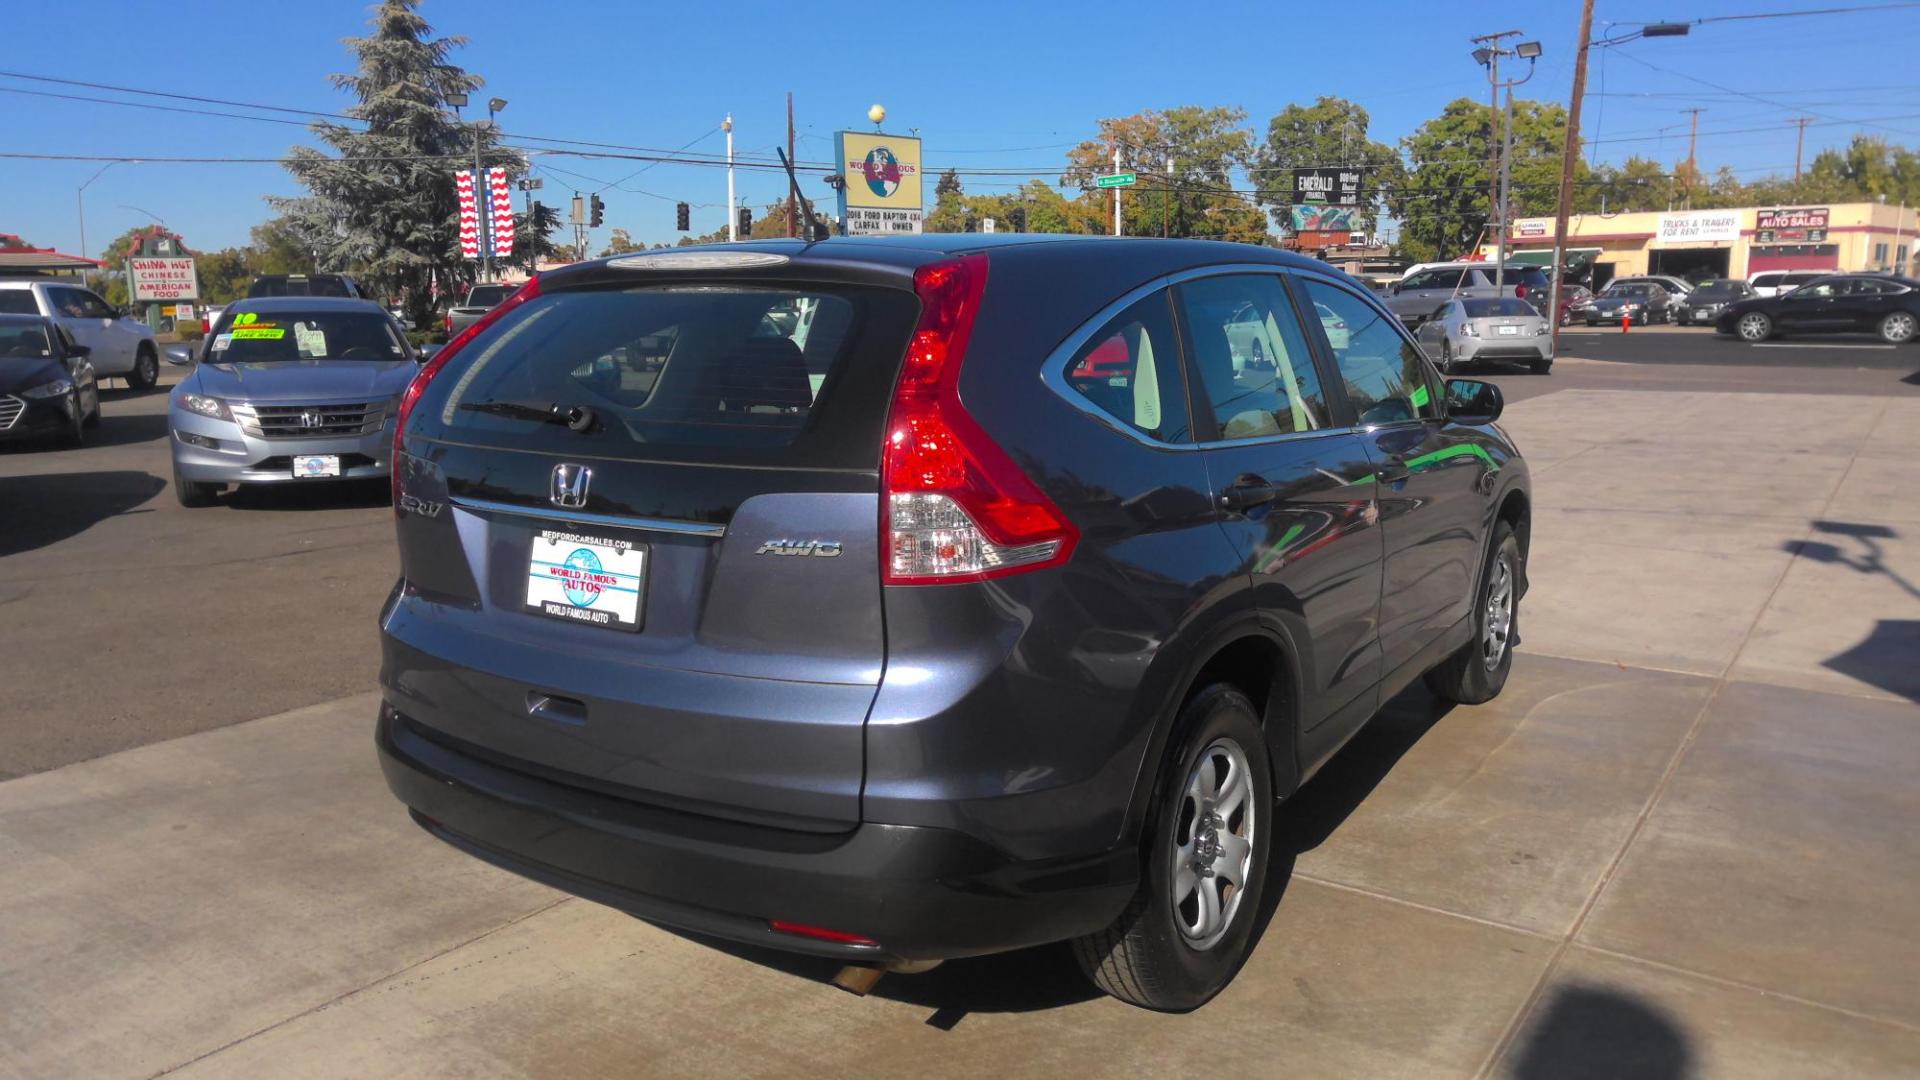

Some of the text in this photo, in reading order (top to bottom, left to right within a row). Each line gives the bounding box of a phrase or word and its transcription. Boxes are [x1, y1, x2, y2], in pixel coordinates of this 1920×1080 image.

[1298, 176, 1333, 191] EMERALD
[864, 211, 880, 219] FORD
[883, 212, 907, 221] RAPTOR
[854, 221, 880, 230] CARFAX
[892, 222, 913, 231] OWNER
[1663, 219, 1689, 228] TRUCKS
[1761, 216, 1824, 227] AUTO SALES
[1663, 228, 1678, 237] FOR
[1680, 227, 1700, 236] RENT
[133, 260, 192, 270] CHINA HUT
[141, 271, 186, 279] CHINESE
[140, 283, 191, 291] AMERICAN
[541, 529, 633, 550] MEDFORDCARSALES.COM
[754, 539, 843, 558] AWD
[550, 567, 617, 585] WORLD FAMOUS
[564, 580, 601, 593] AUTOS
[545, 603, 609, 624] WORLD FAMOUS AUTO
